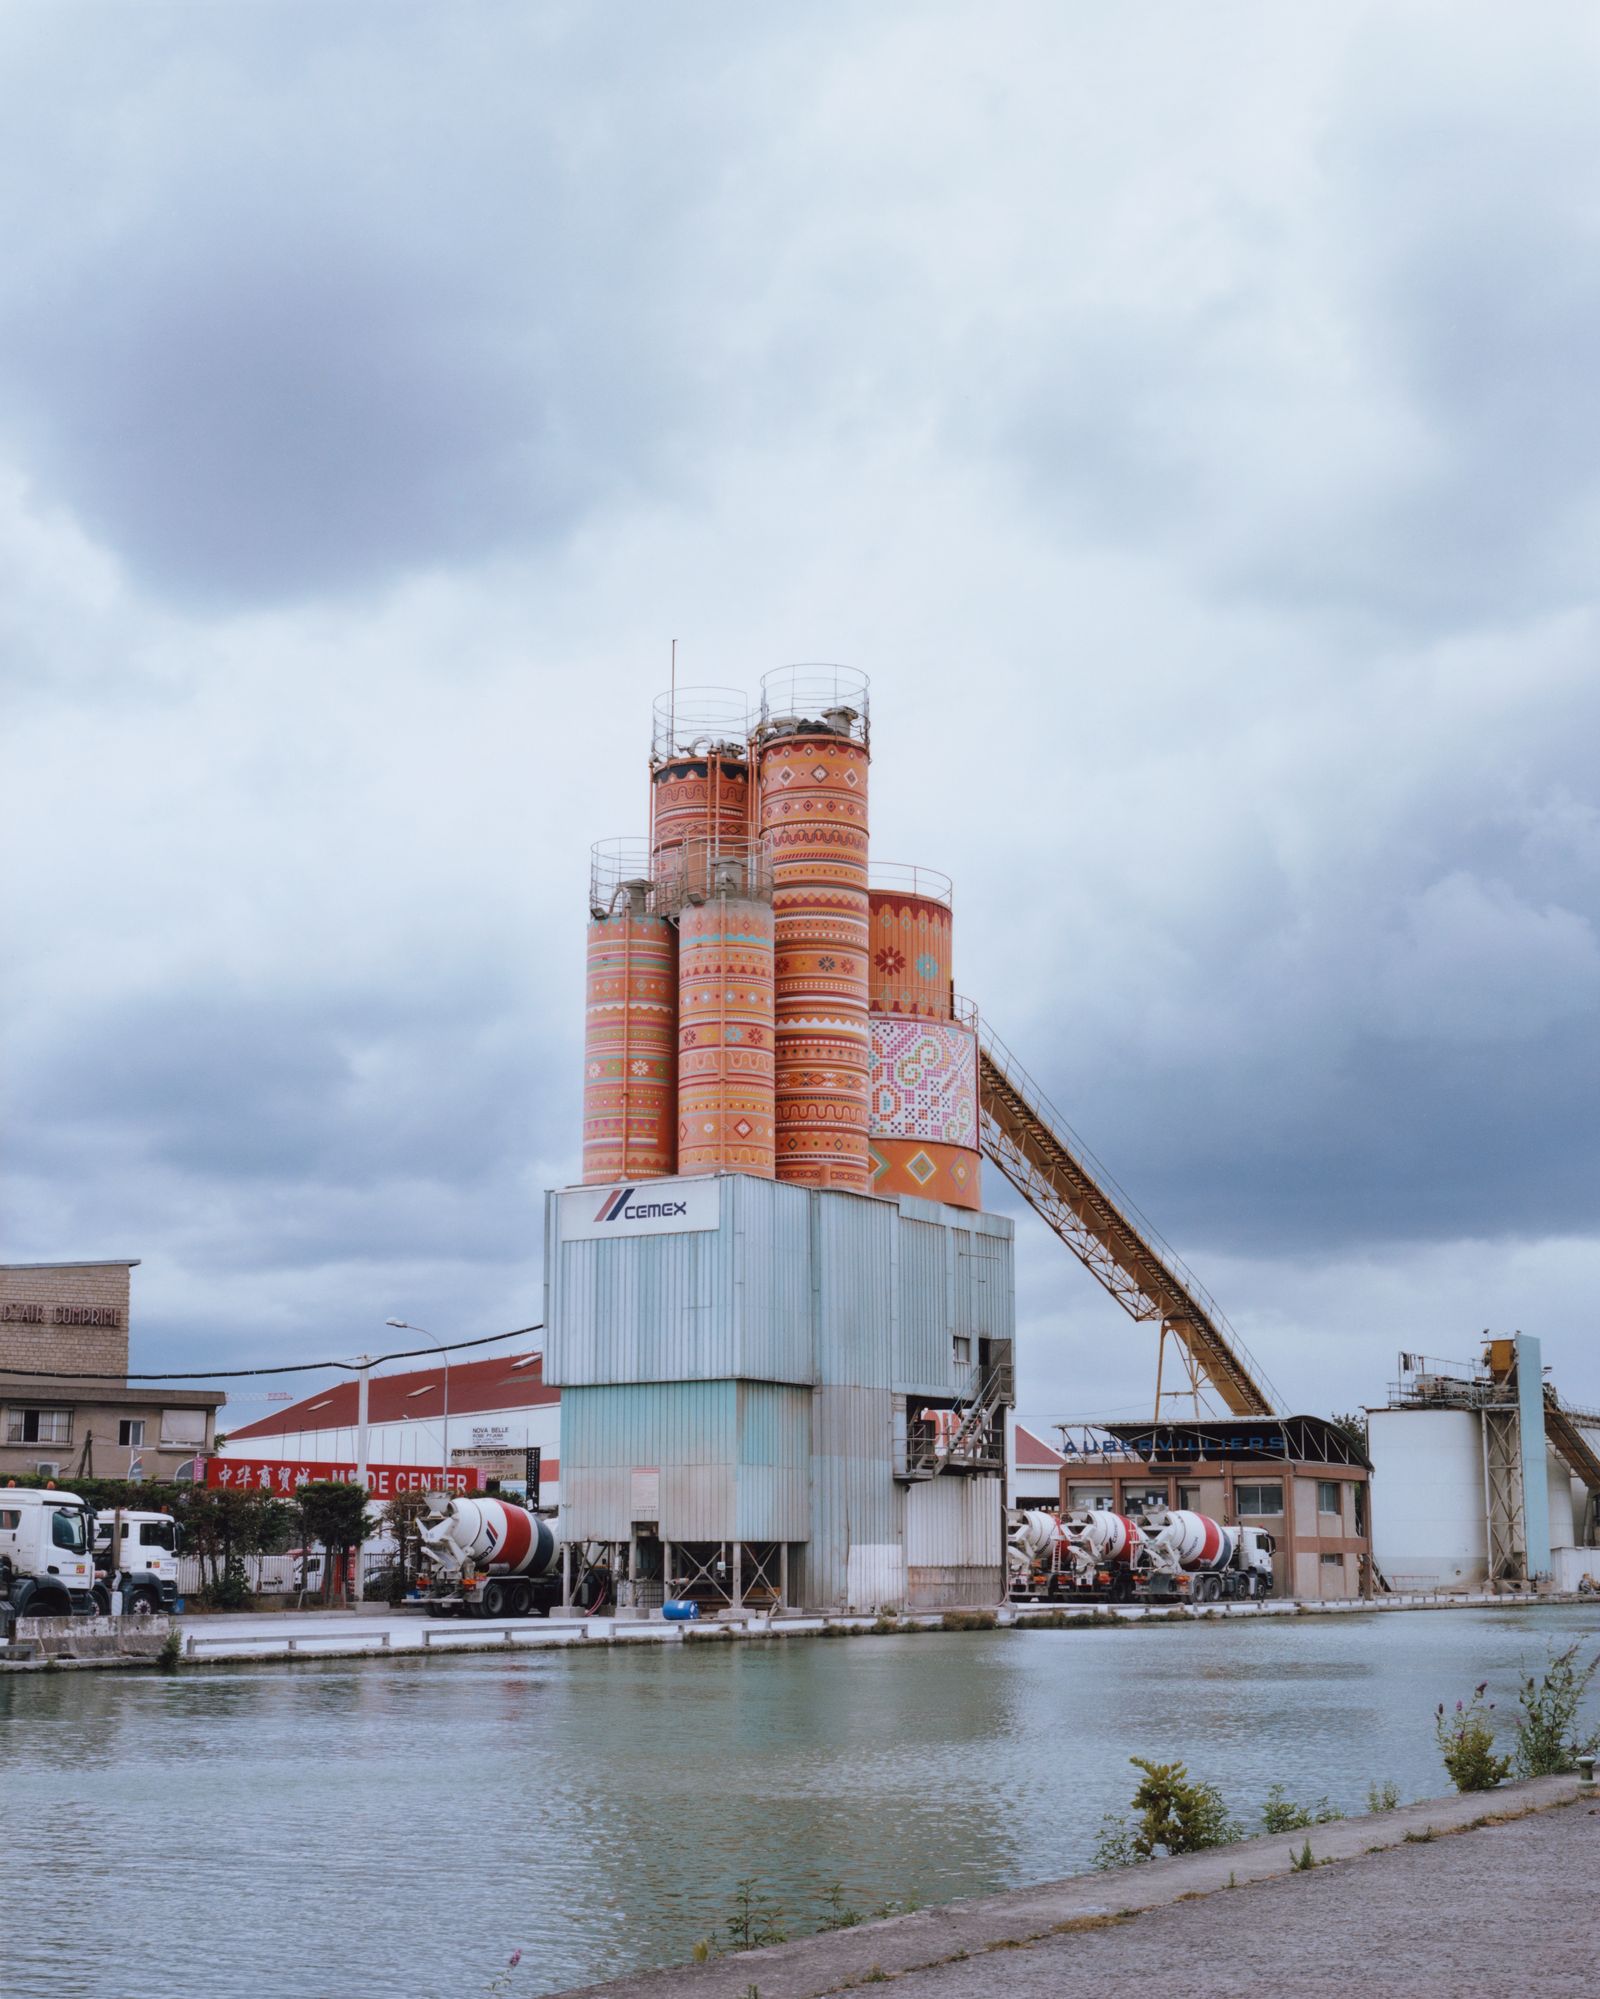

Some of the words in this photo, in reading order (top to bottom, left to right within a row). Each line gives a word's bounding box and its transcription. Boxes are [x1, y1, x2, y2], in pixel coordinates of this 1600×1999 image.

[625, 1202, 687, 1219] CEMEX
[53, 1305, 121, 1326] COMPRIME
[1062, 1437, 1284, 1453] AUBERVILLIERS
[394, 1471, 467, 1495] CENTER
